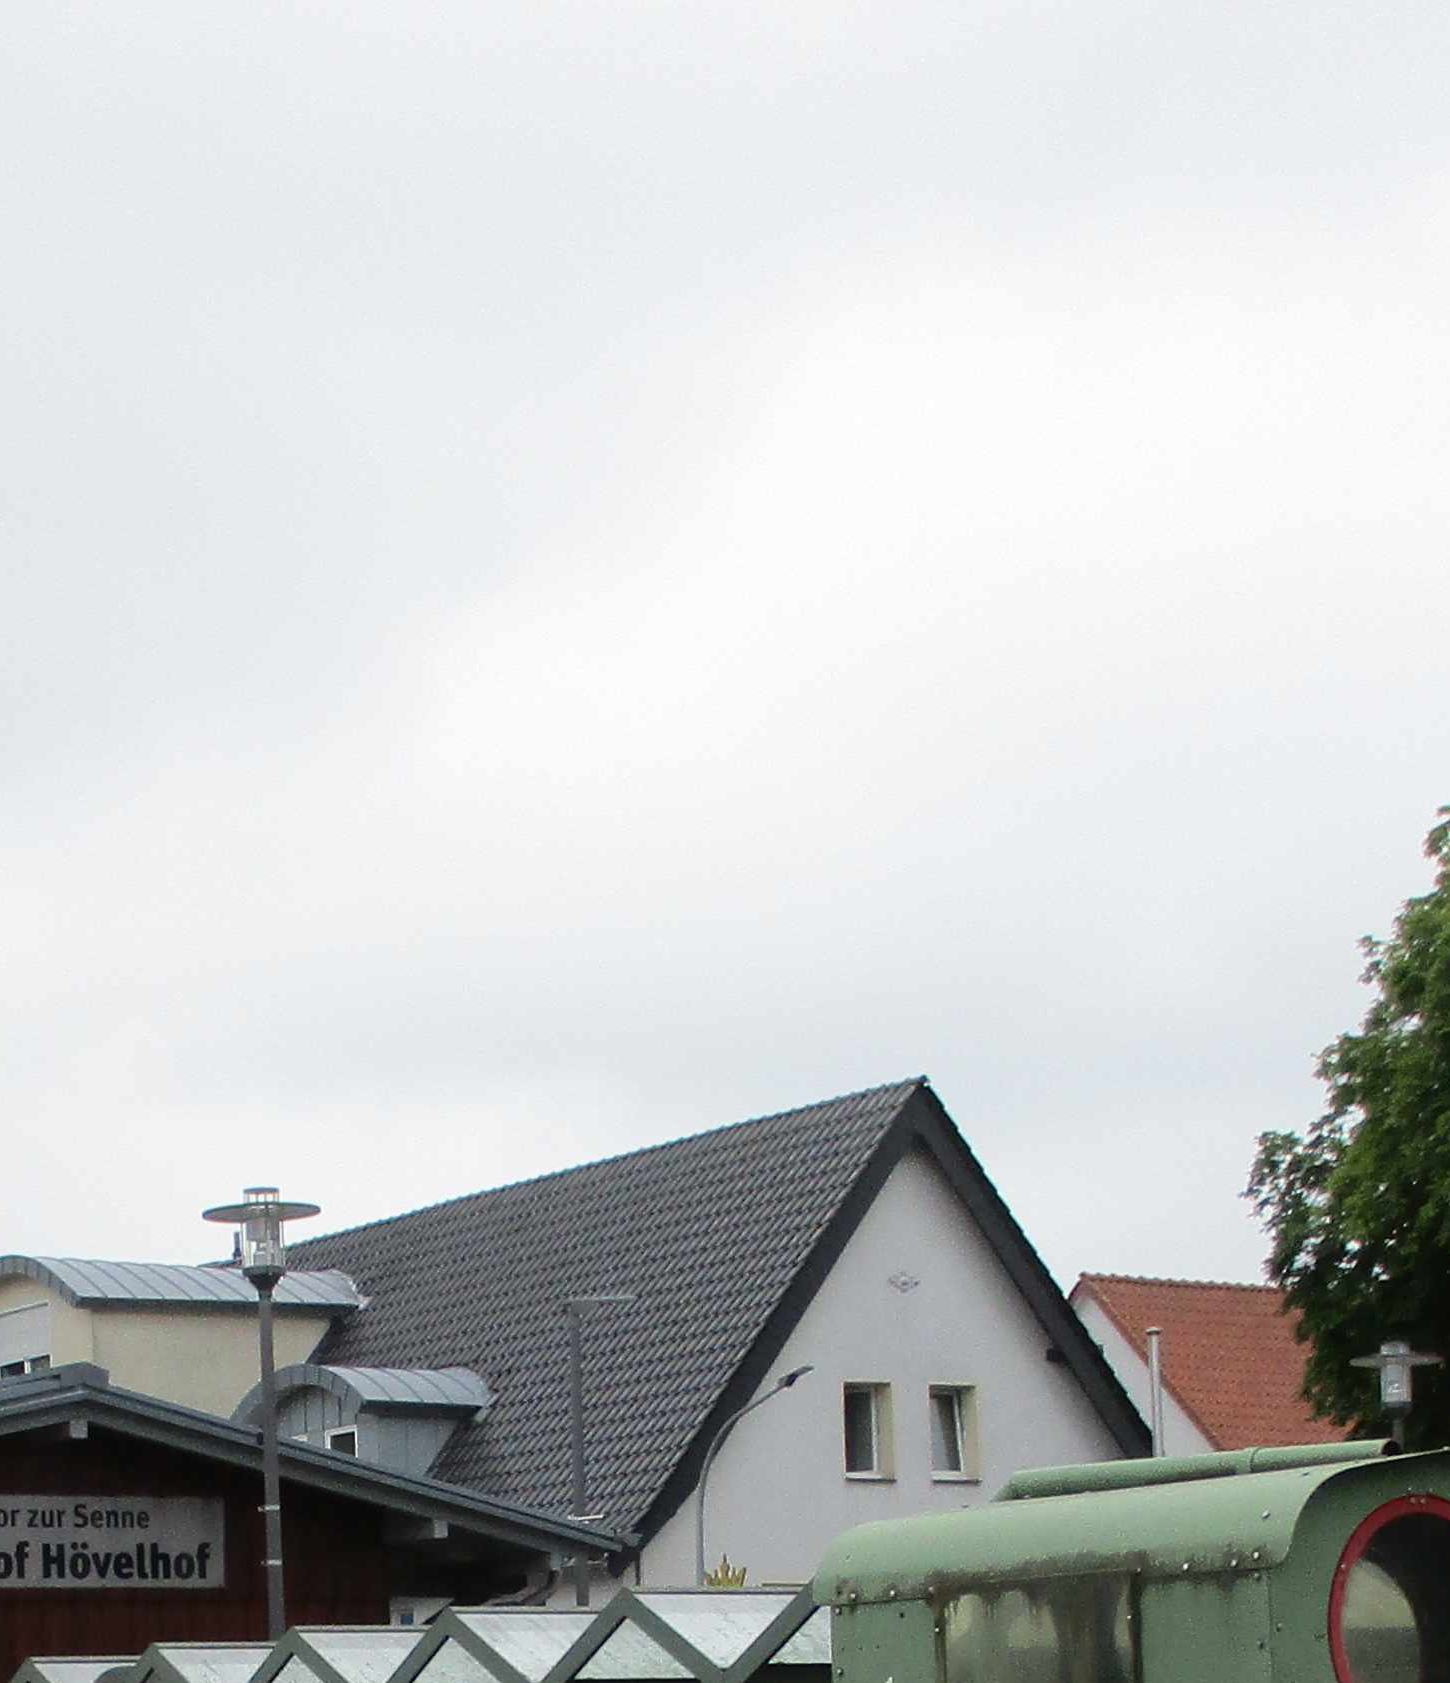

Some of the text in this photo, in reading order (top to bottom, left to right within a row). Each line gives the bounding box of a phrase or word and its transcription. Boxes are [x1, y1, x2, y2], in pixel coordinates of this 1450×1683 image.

[27, 1508, 65, 1528] zur
[73, 1503, 150, 1529] Senne
[42, 1542, 211, 1581] Hövelhof
